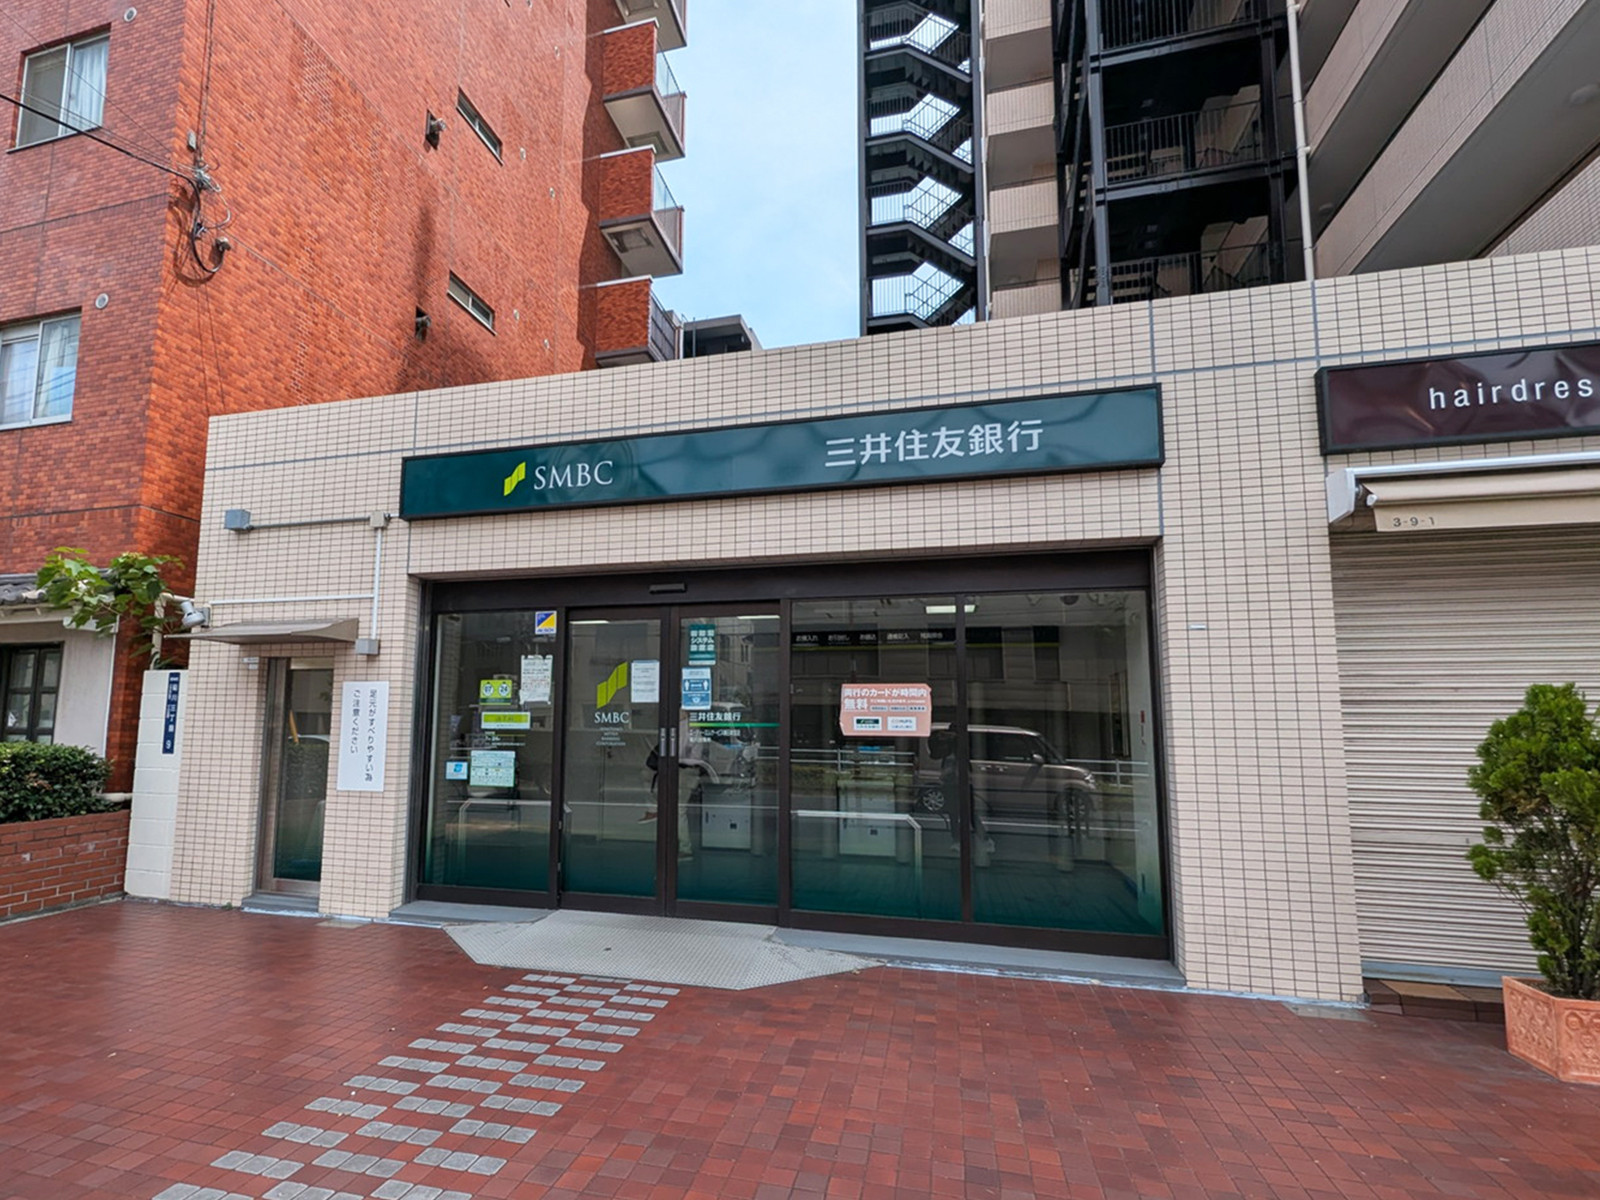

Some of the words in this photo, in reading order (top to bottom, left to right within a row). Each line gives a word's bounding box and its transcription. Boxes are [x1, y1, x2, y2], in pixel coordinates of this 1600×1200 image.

[1429, 378, 1594, 410] hairdres
[824, 419, 1044, 468] 三井住友銀行
[533, 460, 614, 491] SMBC
[1393, 517, 1435, 528] 3-9-1
[594, 711, 630, 724] SMBC
[689, 711, 741, 721] 三井住友銀行
